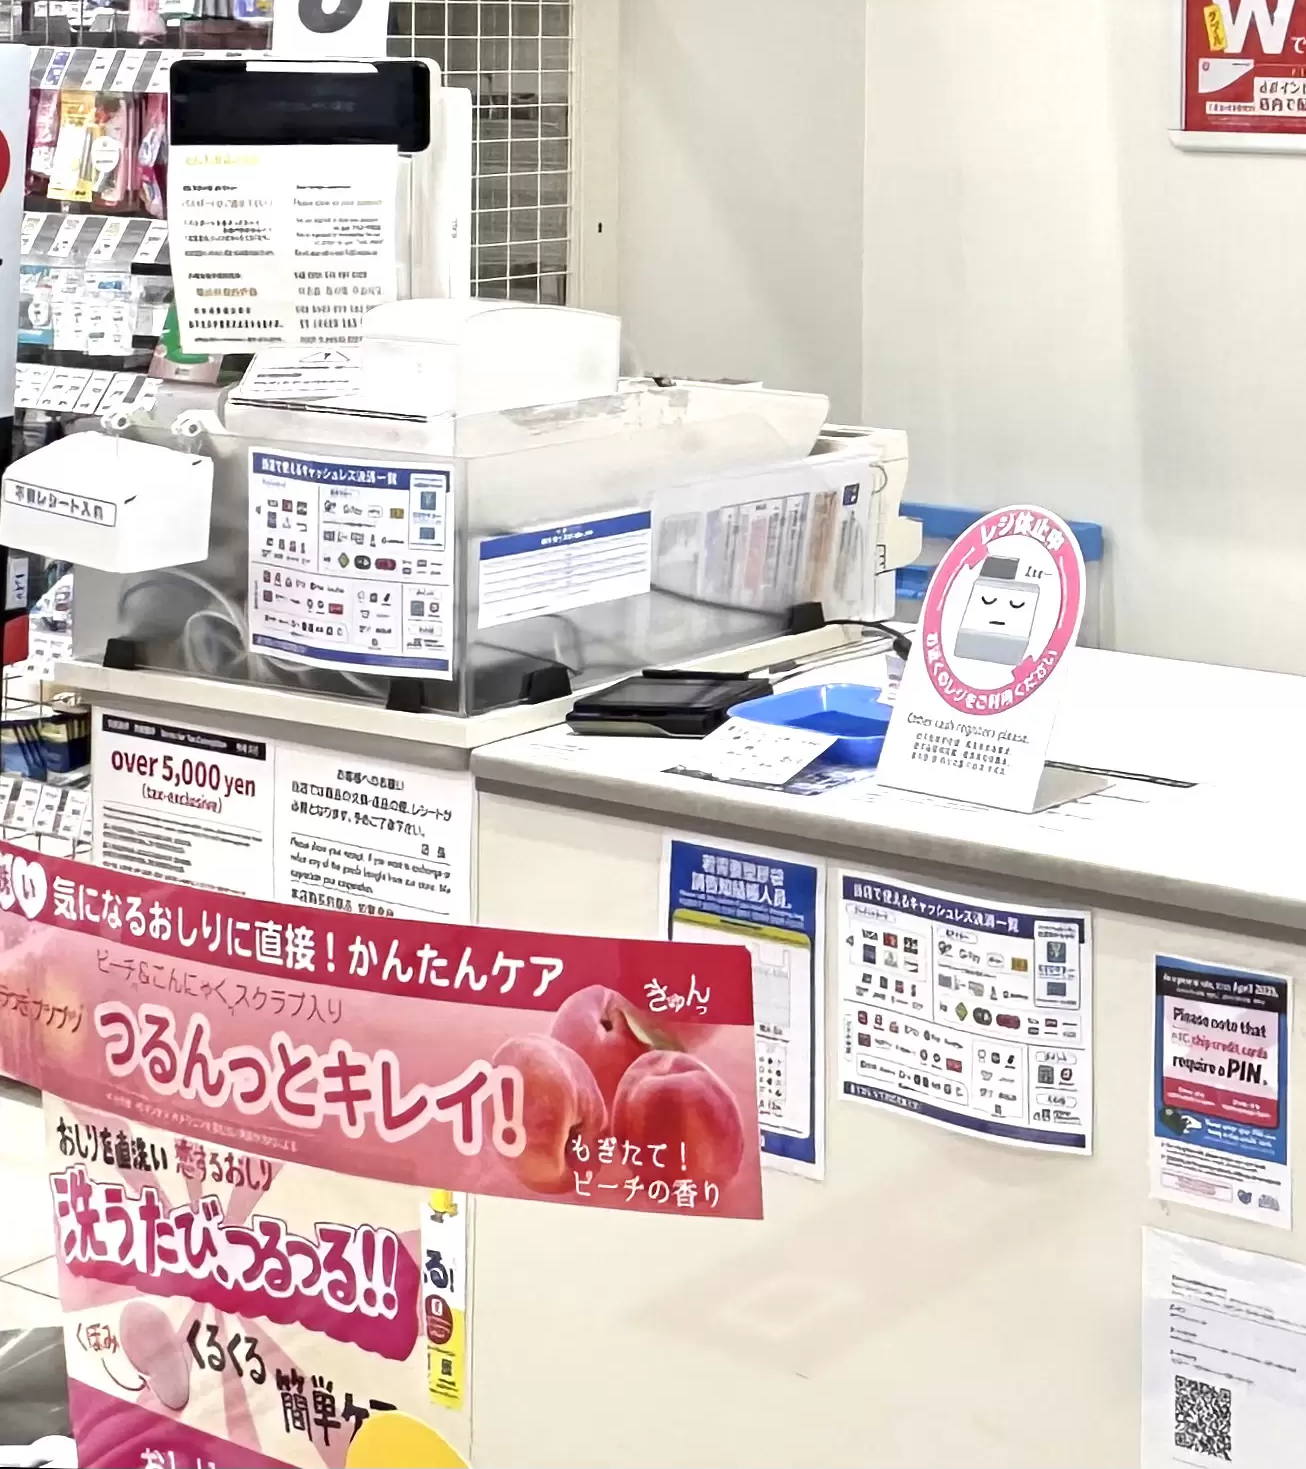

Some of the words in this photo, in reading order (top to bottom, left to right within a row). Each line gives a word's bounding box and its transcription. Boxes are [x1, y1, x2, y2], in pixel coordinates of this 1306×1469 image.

[980, 511, 1065, 551] レジ休止中
[111, 747, 159, 779] over
[161, 754, 221, 791] 5,000
[223, 771, 256, 797] yen
[1173, 1007, 1209, 1027] Please
[1240, 1020, 1266, 1038] that
[1227, 1058, 1267, 1086] PIN.
[570, 1137, 690, 1173] もぎたて！
[573, 1177, 722, 1210] ピーチの香り
[186, 1319, 266, 1385] くるくる
